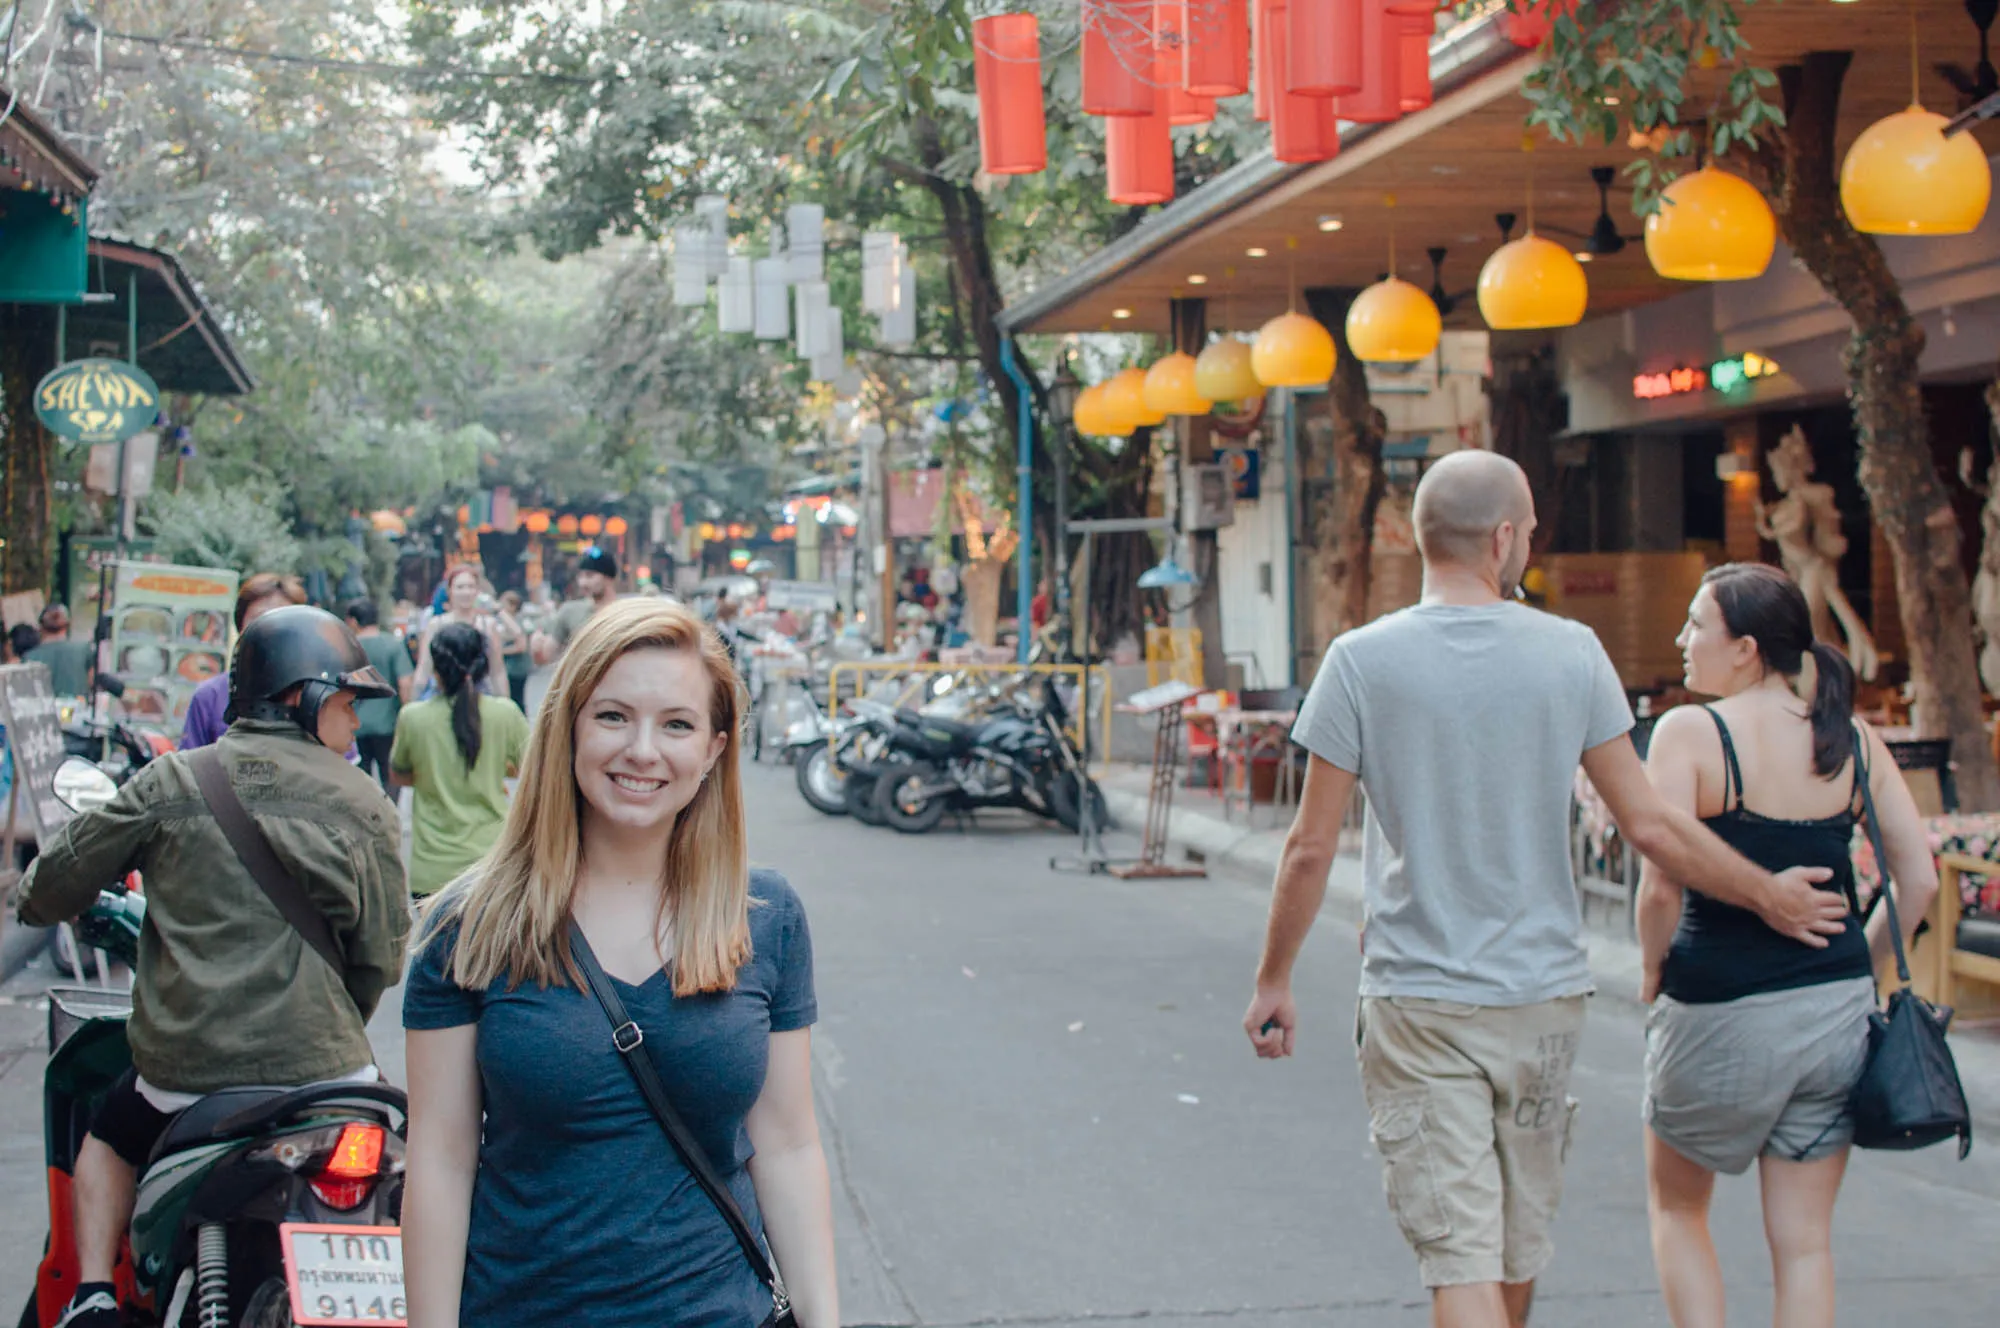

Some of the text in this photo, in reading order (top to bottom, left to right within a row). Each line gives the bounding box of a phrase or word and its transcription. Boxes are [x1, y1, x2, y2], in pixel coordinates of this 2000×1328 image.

[42, 372, 153, 410] SHEWA
[69, 410, 123, 432] SPA
[317, 1294, 405, 1319] 9146
